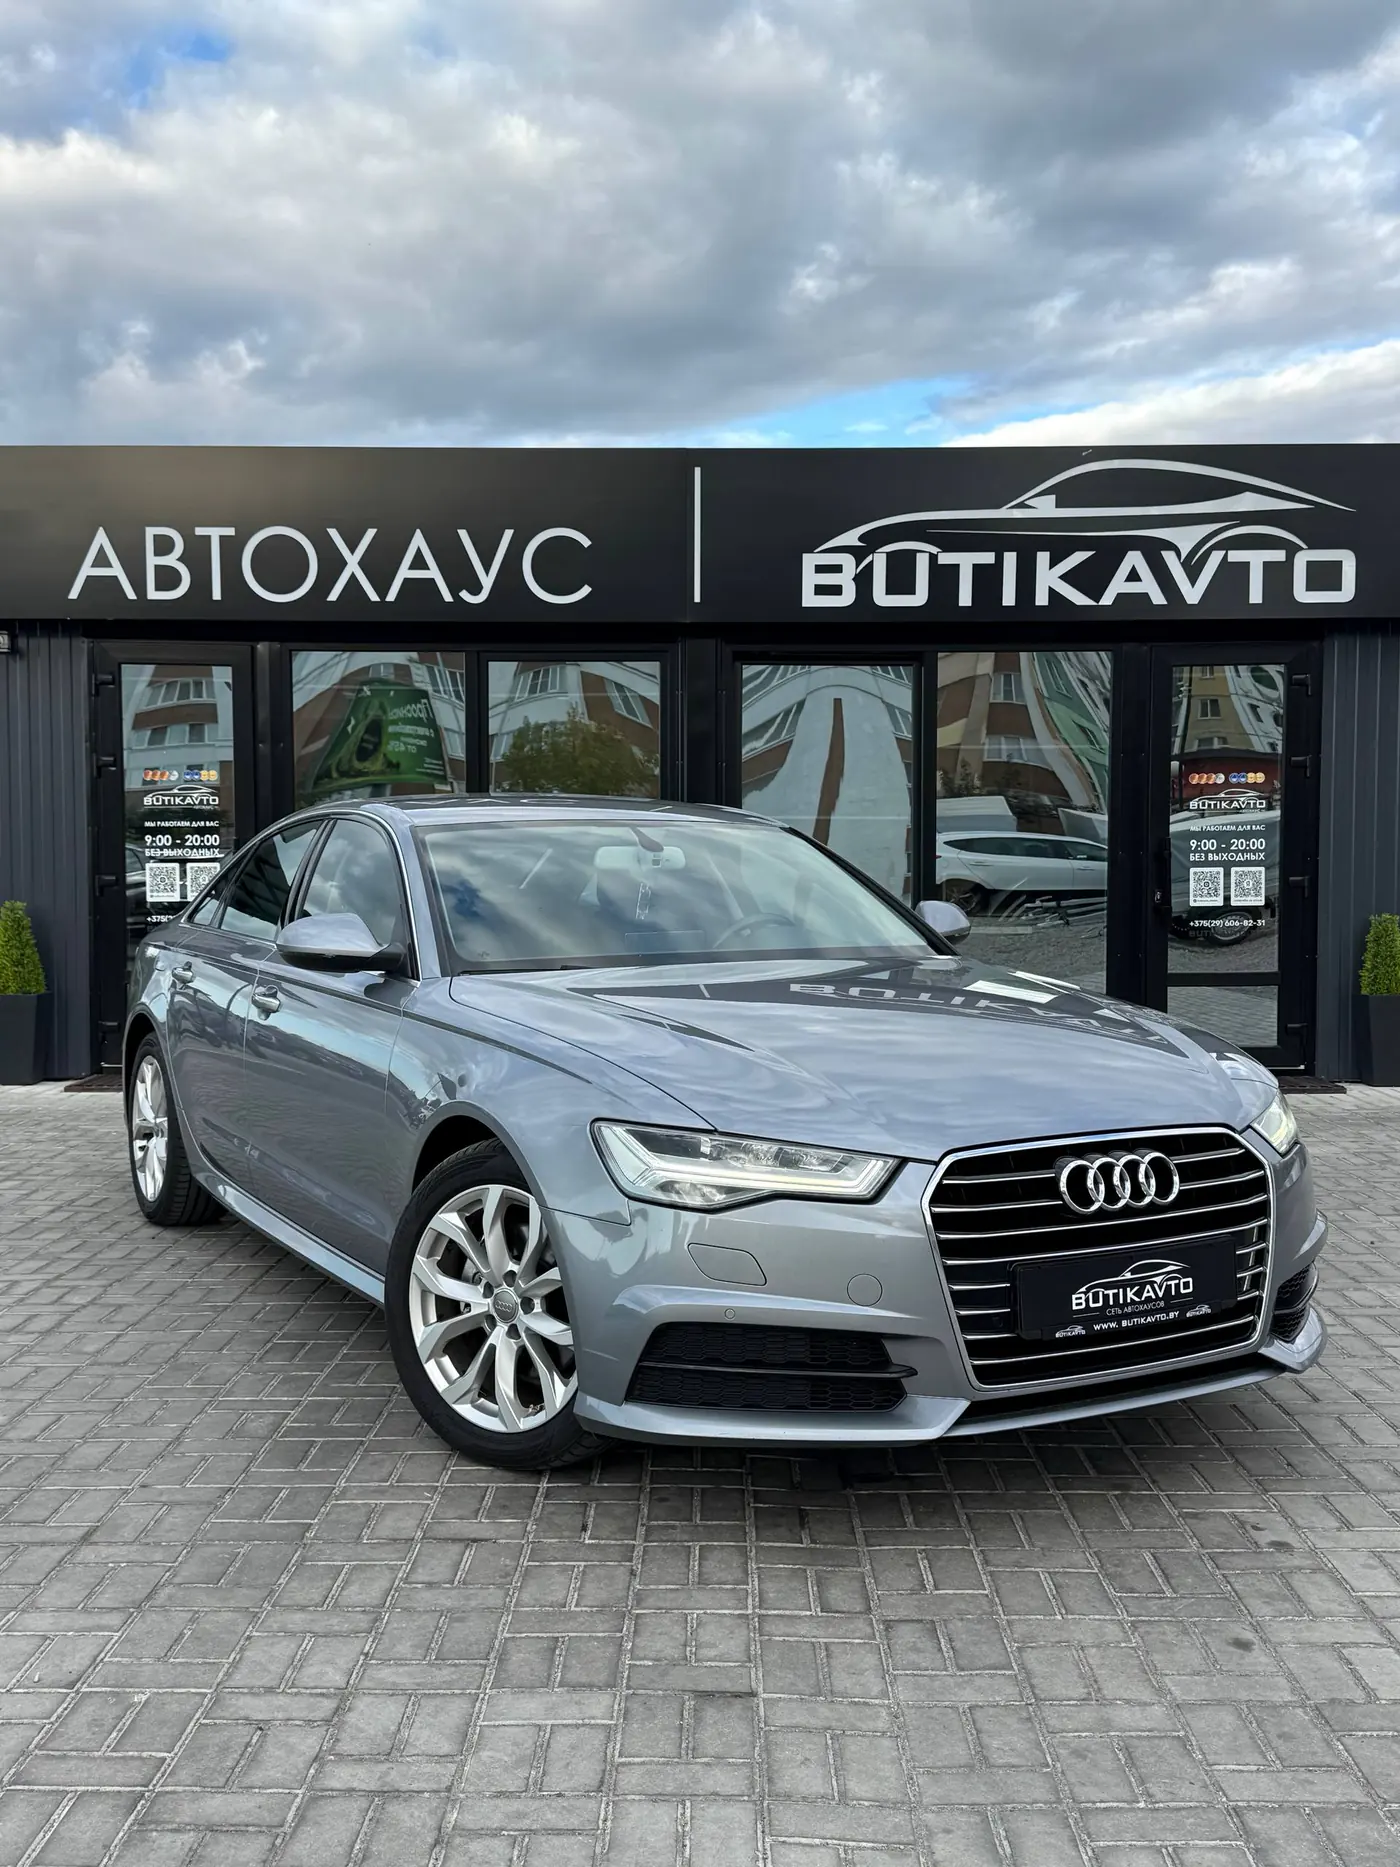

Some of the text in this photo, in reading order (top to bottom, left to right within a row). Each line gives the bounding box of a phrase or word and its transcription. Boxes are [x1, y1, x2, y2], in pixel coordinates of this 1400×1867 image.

[67, 525, 593, 604] АВТОХАУС
[801, 548, 1357, 608] BUTIKAVTO
[143, 796, 219, 806] BUTIKAVTO
[1189, 800, 1266, 810] BUTIKAVTO
[144, 834, 172, 846] 9:00
[184, 834, 220, 846] 20:00
[1189, 839, 1217, 851] 9:00
[1230, 838, 1266, 850] 20:00
[144, 848, 220, 857] БЕЗ ВЫХОДНЫХ
[1189, 852, 1266, 862] БЕЗ ВЫХОДНЫХ
[1189, 919, 1266, 928] +375(29) 606-82-31
[1072, 1277, 1193, 1310] BUTIKAVTO
[1106, 1300, 1165, 1316] СЕТЬ АВТОХАУСОВ
[1093, 1311, 1180, 1331] WWW. BUTIKAVTO.BY
